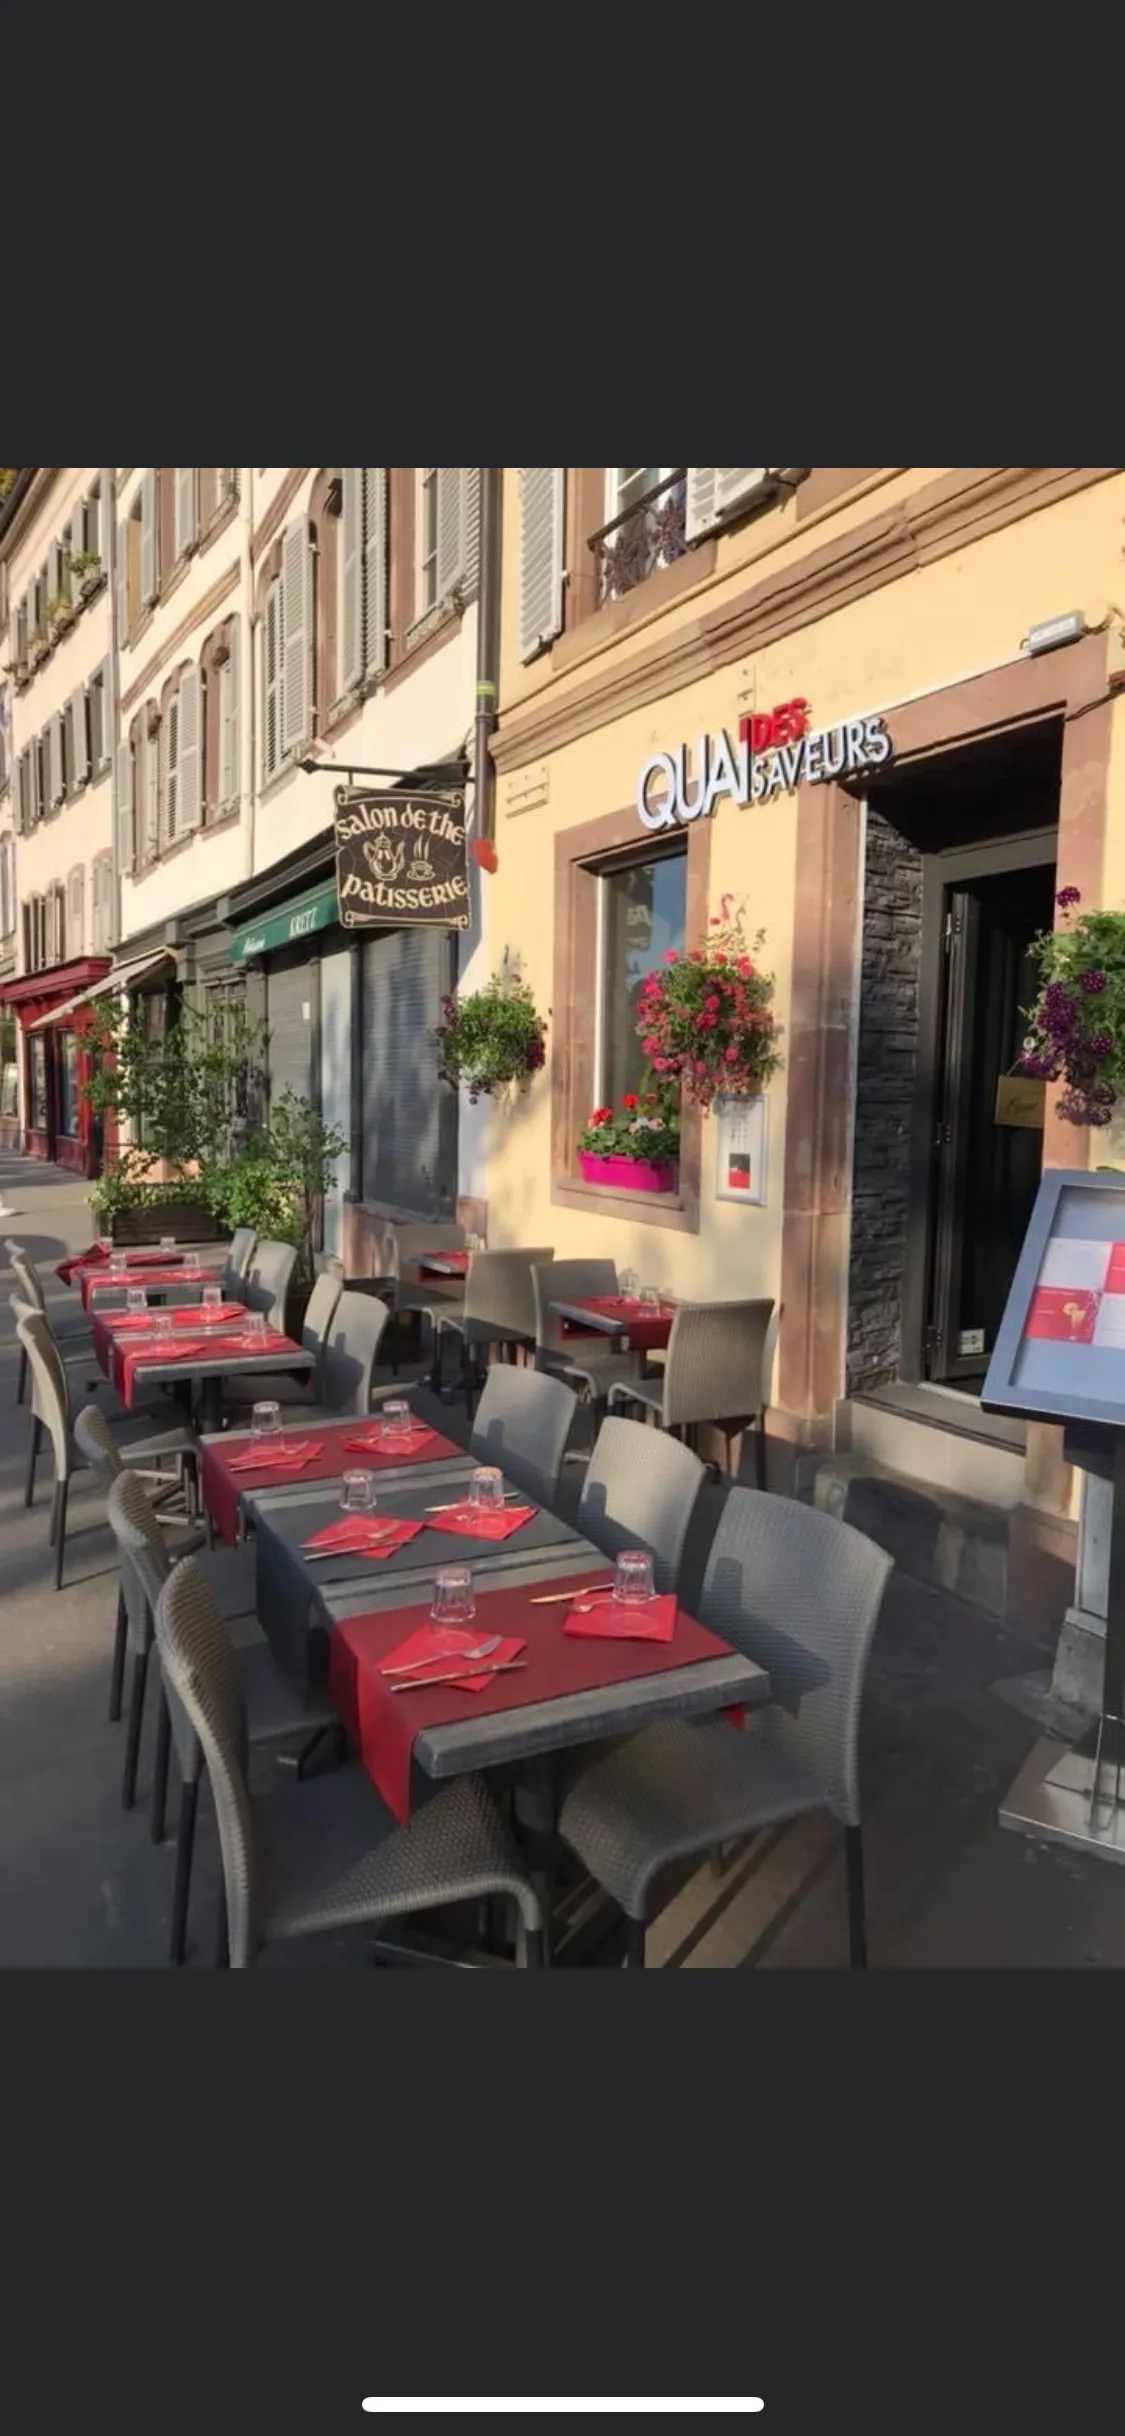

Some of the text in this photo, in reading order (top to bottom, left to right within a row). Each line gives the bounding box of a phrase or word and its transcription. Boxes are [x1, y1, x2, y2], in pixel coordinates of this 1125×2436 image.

[751, 697, 808, 752] DES
[751, 717, 892, 799] SAVEURS
[636, 717, 752, 830] QUAI
